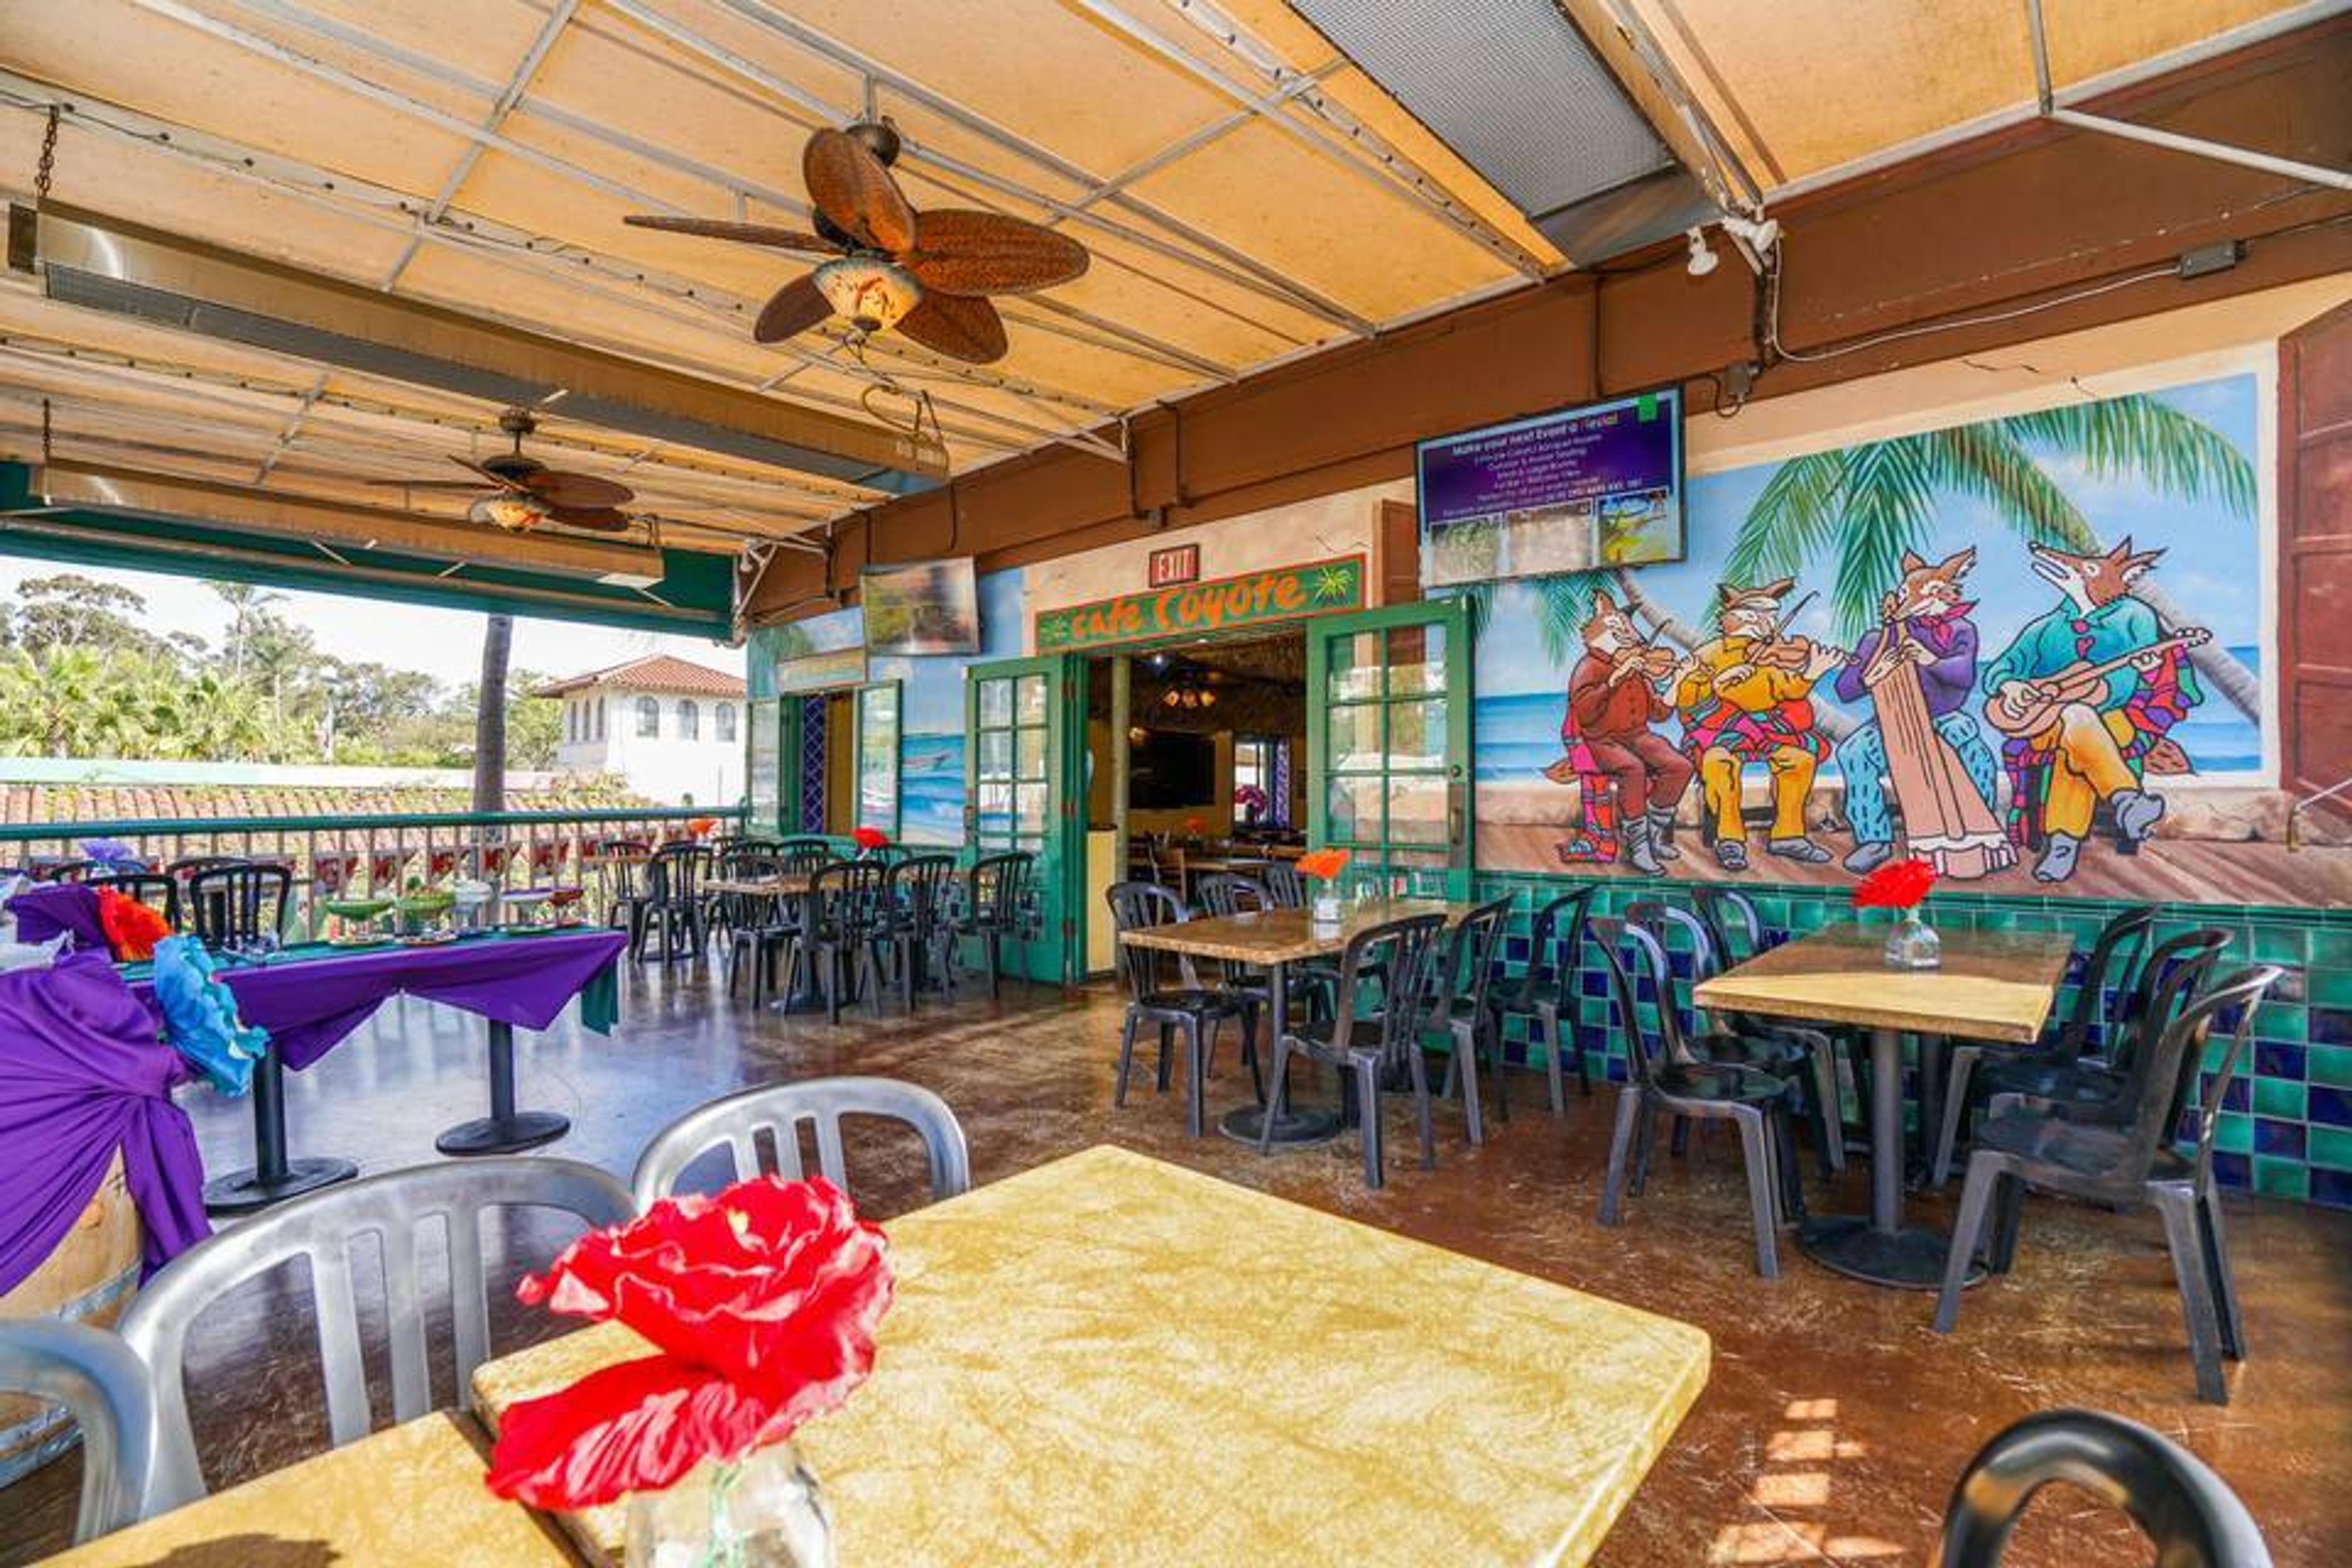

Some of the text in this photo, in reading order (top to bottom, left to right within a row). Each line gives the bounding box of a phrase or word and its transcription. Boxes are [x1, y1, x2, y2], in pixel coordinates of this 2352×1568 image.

[1452, 442, 1481, 456] Make
[1536, 424, 1567, 440] Event
[1158, 549, 1190, 582] EXIT
[1154, 573, 1306, 631] Coyote
